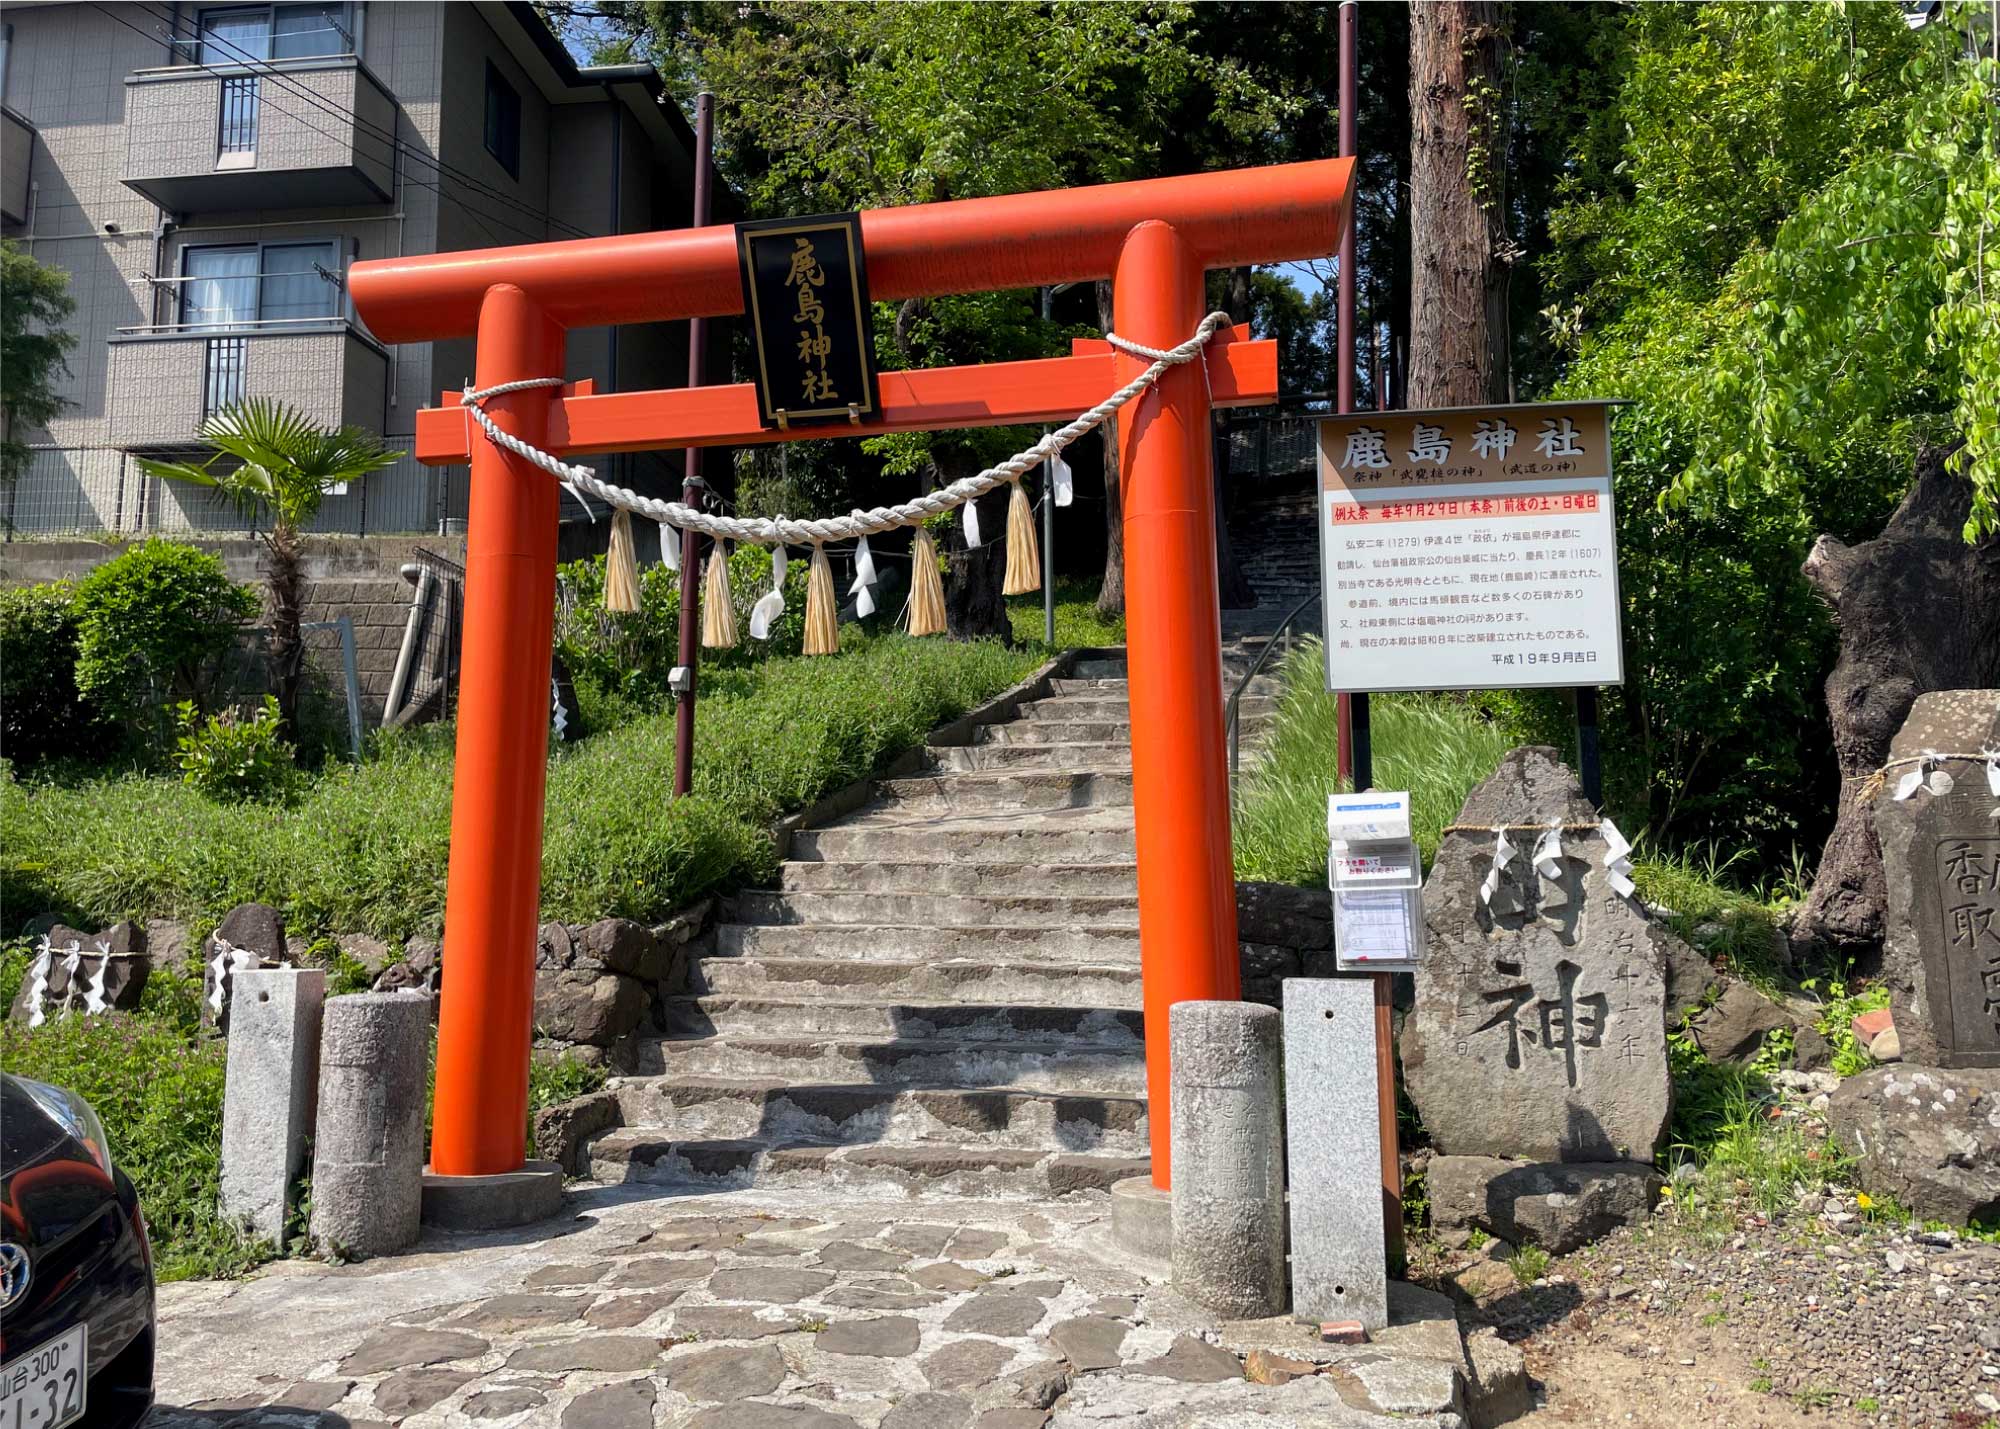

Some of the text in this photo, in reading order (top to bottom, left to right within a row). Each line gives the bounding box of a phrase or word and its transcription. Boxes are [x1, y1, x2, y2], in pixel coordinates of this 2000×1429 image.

[784, 238, 839, 404] 鹿島神社
[1341, 416, 1586, 469] 鹿島神社
[1335, 506, 1369, 521] 例大祭
[1491, 651, 1597, 665] 平成19年9月吉日
[0, 1368, 77, 1429] 1-32
